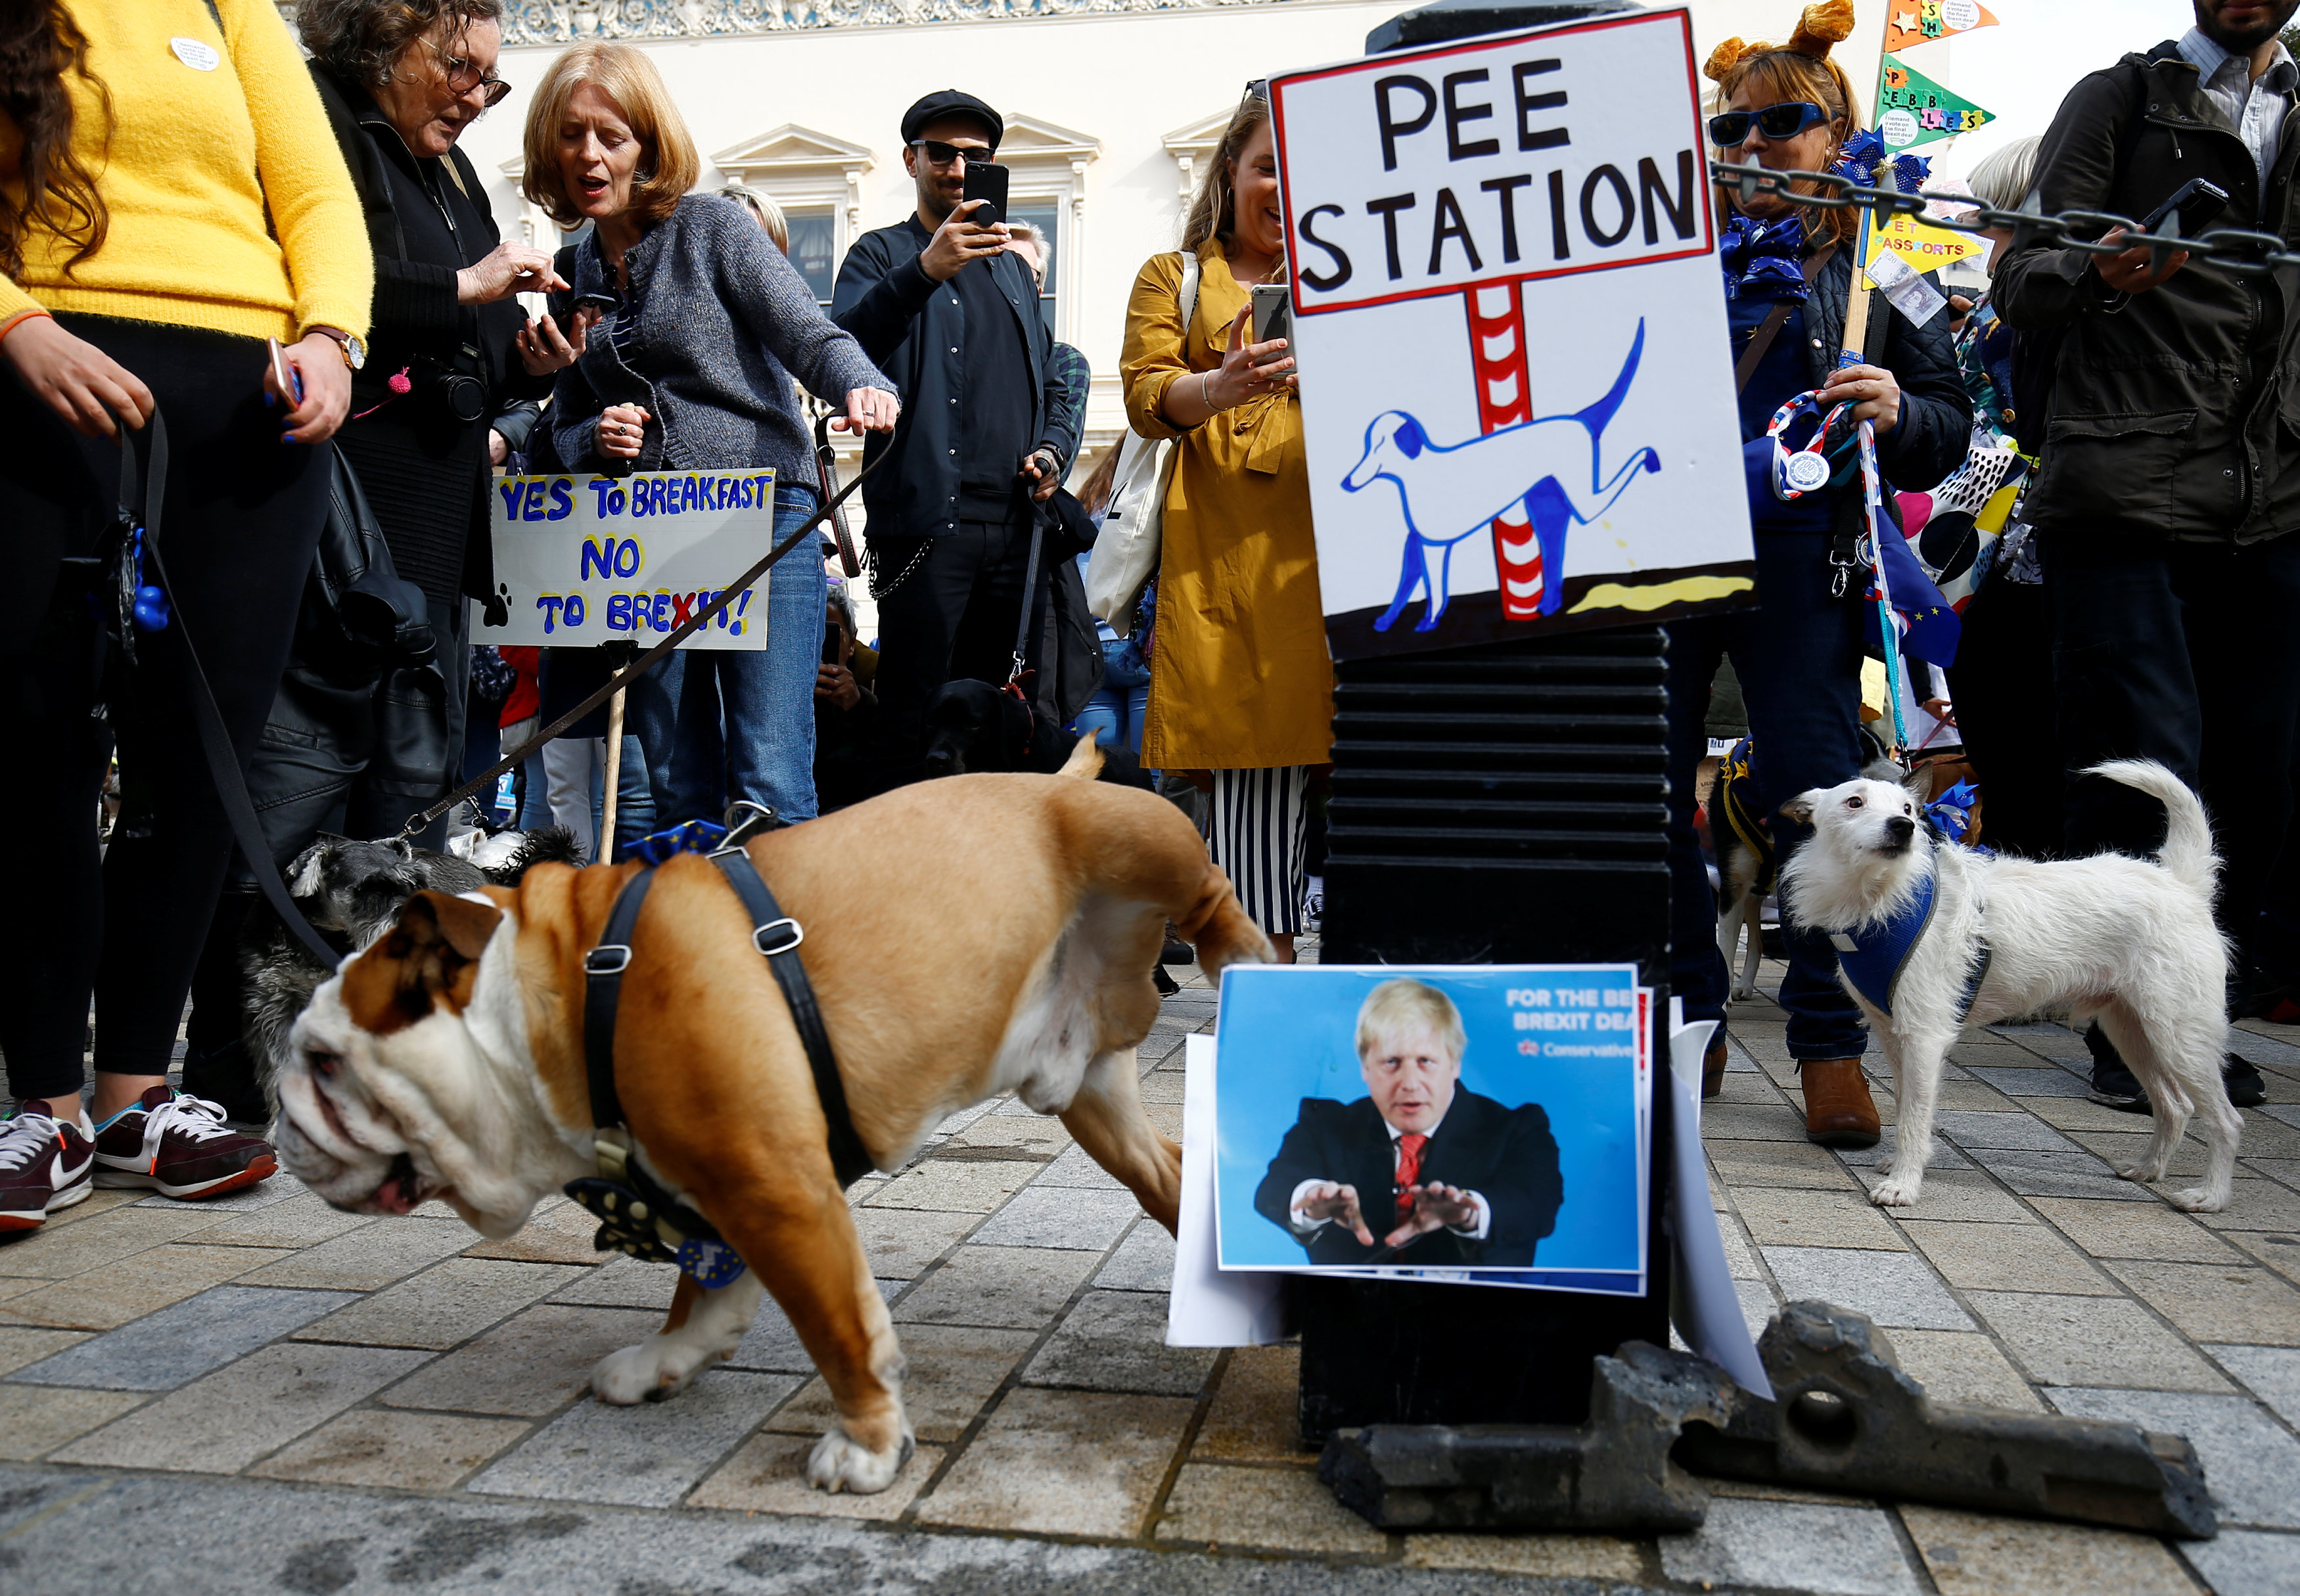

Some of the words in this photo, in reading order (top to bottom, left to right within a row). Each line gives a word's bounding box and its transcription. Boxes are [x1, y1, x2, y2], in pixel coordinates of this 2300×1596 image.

[1374, 58, 1571, 172] PEE
[1298, 148, 1696, 292] STATION
[1874, 235, 1964, 256] PASSPORTS
[499, 476, 574, 522] YES
[631, 475, 773, 518] BREAKFAST
[580, 537, 640, 581] NO
[536, 594, 586, 634] TO
[607, 589, 754, 637] BREXIT!
[1506, 988, 1552, 1007] FOR
[1555, 989, 1599, 1007] THE
[1513, 1012, 1591, 1031] BREXIT
